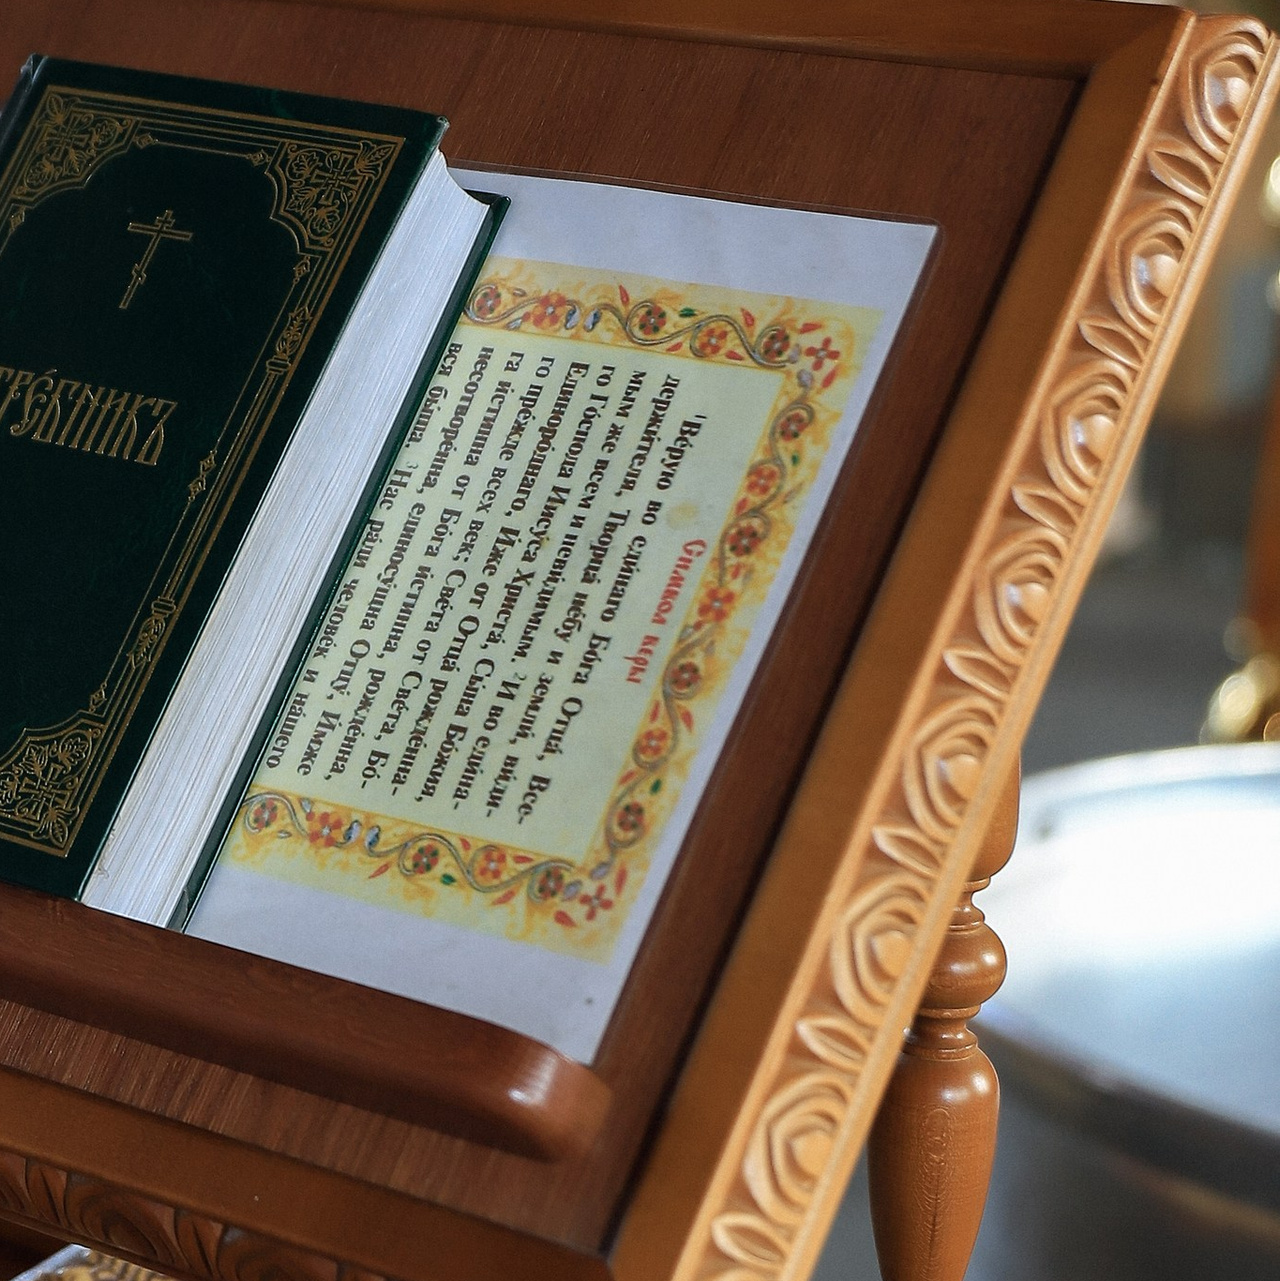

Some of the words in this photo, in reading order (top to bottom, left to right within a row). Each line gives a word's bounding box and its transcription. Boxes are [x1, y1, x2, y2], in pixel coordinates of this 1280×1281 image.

[437, 341, 464, 377] вся
[502, 350, 525, 373] га
[534, 355, 556, 379] го
[594, 363, 616, 387] го
[614, 369, 648, 419] мым
[599, 421, 625, 454] же
[449, 473, 471, 501] от
[474, 465, 508, 514] всех
[576, 457, 611, 510] всем
[568, 513, 587, 529] и
[640, 498, 663, 526] во
[451, 518, 485, 563] век;
[467, 580, 490, 610] от
[410, 637, 432, 666] от
[545, 649, 564, 665] и
[301, 668, 320, 683] и
[481, 703, 505, 732] во
[516, 773, 552, 825] Все-
